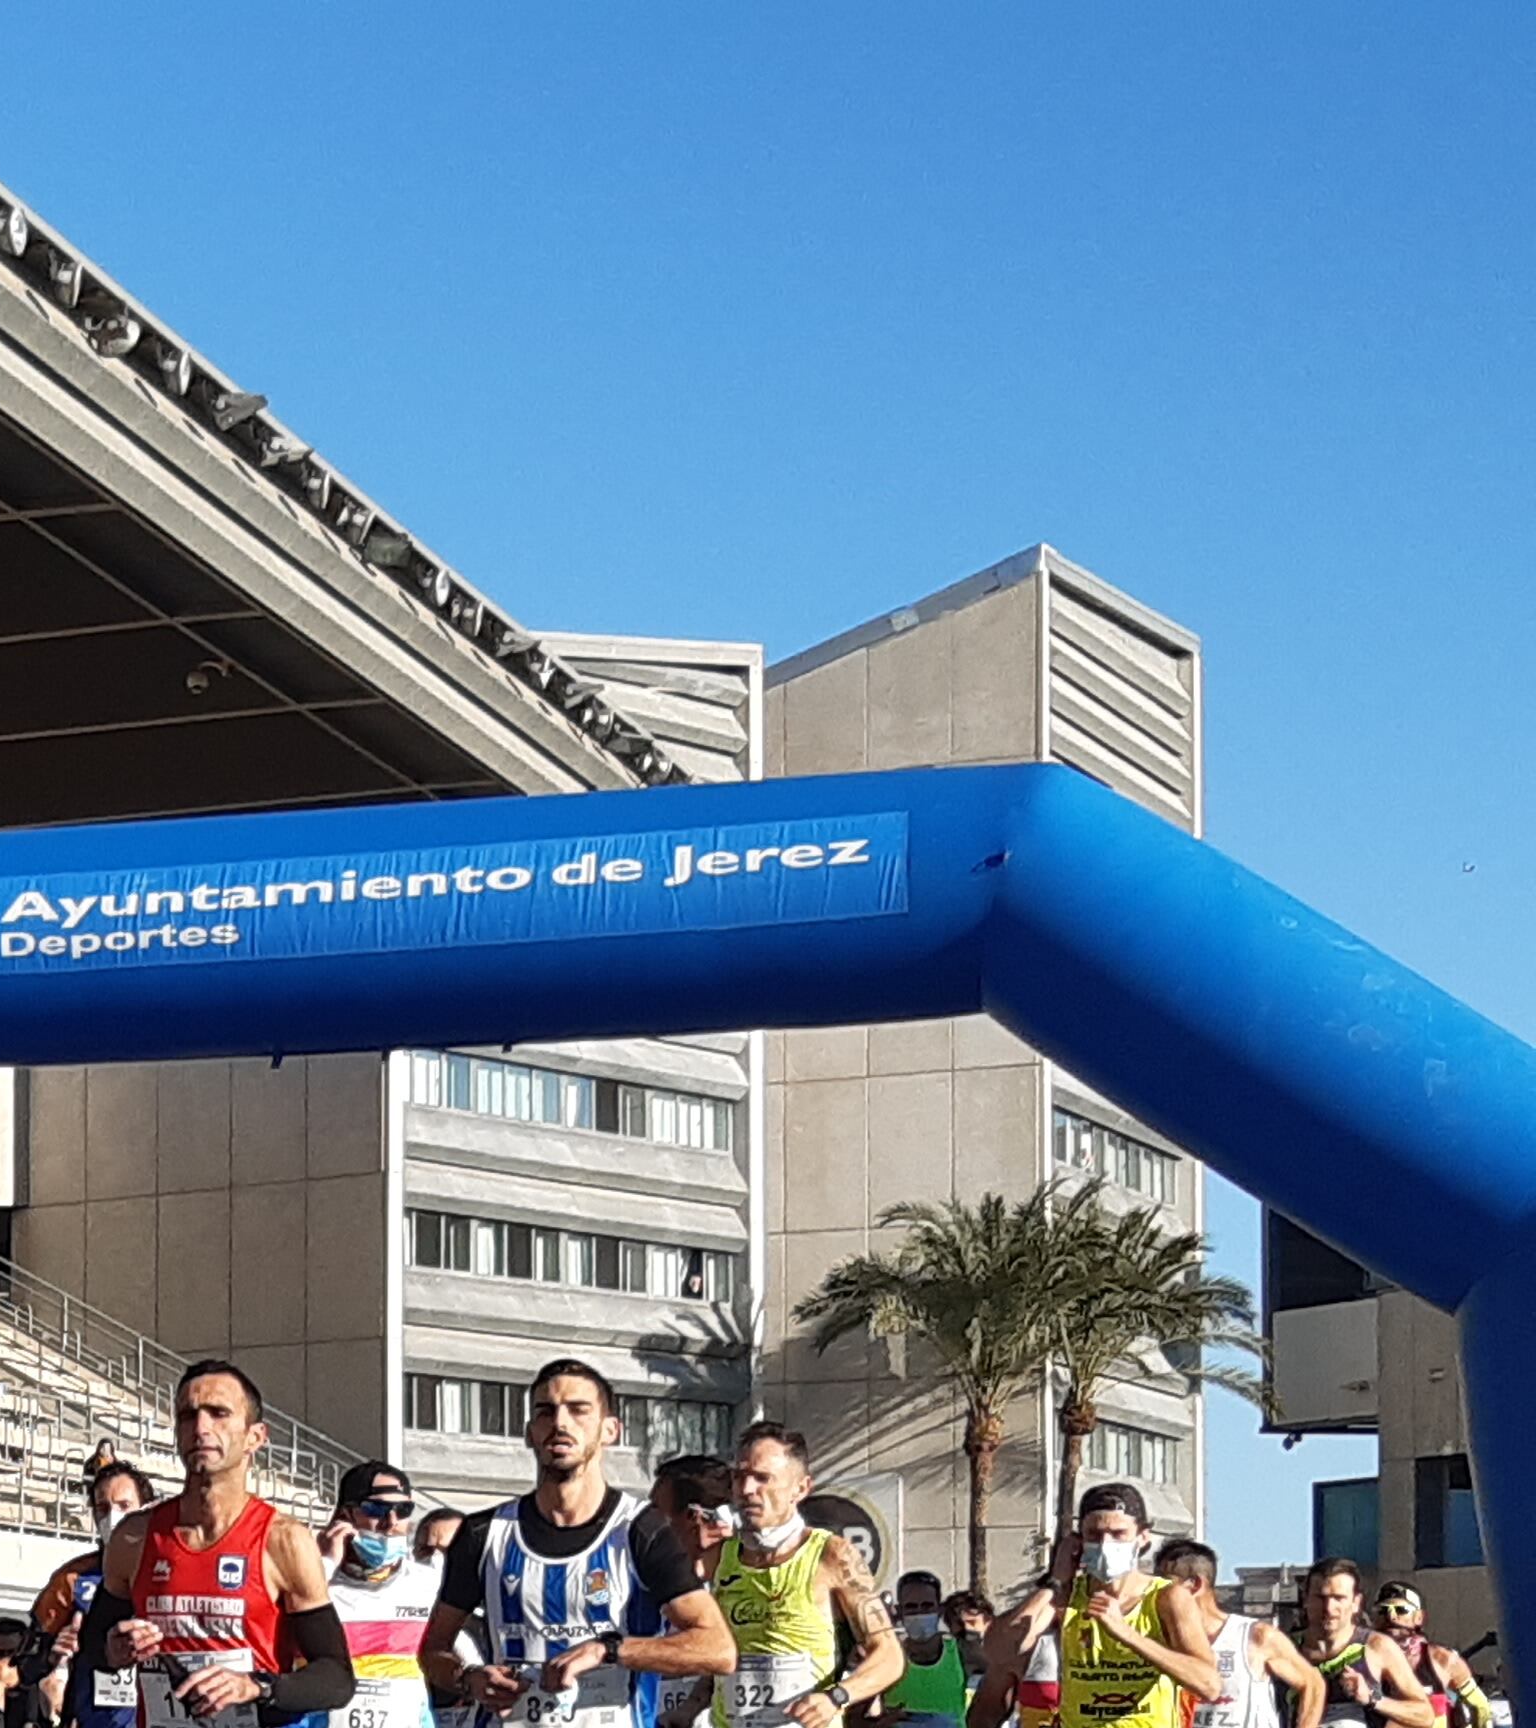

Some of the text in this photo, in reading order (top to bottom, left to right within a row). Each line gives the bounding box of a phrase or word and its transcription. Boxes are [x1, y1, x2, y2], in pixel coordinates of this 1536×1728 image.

[0, 837, 870, 929] Ayuntamiento de Jerez
[0, 921, 240, 960] Deportes
[734, 1684, 775, 1708] 322
